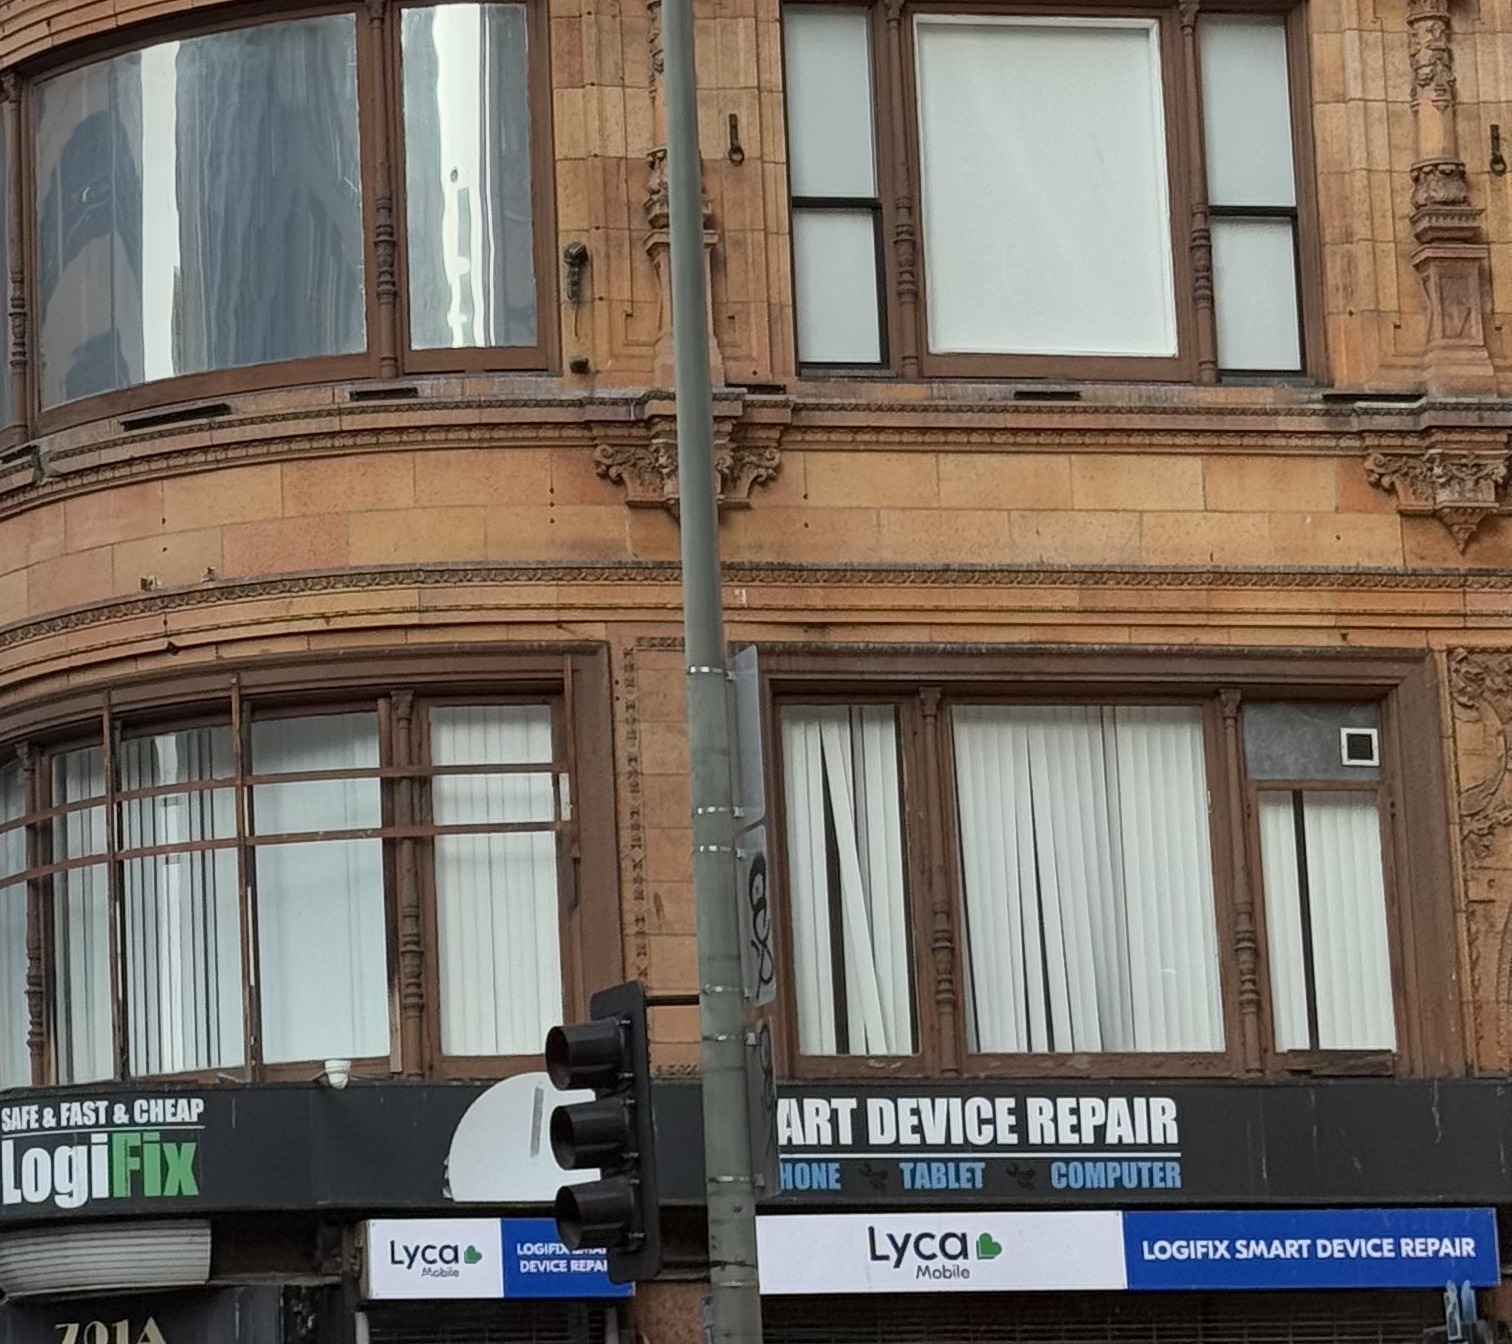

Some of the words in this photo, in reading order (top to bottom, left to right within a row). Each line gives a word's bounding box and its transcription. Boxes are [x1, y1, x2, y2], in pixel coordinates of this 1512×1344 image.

[1, 1104, 39, 1132] SAFE
[42, 1106, 57, 1129] &
[60, 1100, 109, 1127] FAST
[113, 1102, 130, 1125] &
[133, 1098, 205, 1124] CHEAP
[777, 1098, 858, 1146] ART
[866, 1097, 1019, 1146] DEVICE
[1026, 1097, 1179, 1146] REPAIR
[1, 1131, 200, 1209] LogiFix
[778, 1162, 842, 1191] HONE
[899, 1162, 986, 1190] TABLET
[1050, 1161, 1182, 1190] COMPUTER
[390, 1240, 459, 1270] Lyca
[516, 1242, 570, 1256] LOGIFIX
[868, 1225, 970, 1269] Lyca
[1142, 1239, 1232, 1261] LOGIFIX
[1235, 1238, 1311, 1260] SMART
[1316, 1237, 1396, 1259] DEVICE
[1400, 1237, 1477, 1258] REPAIR
[520, 1259, 568, 1273] DEVICE
[570, 1259, 608, 1273] REPAI
[915, 1264, 971, 1281] Mobile
